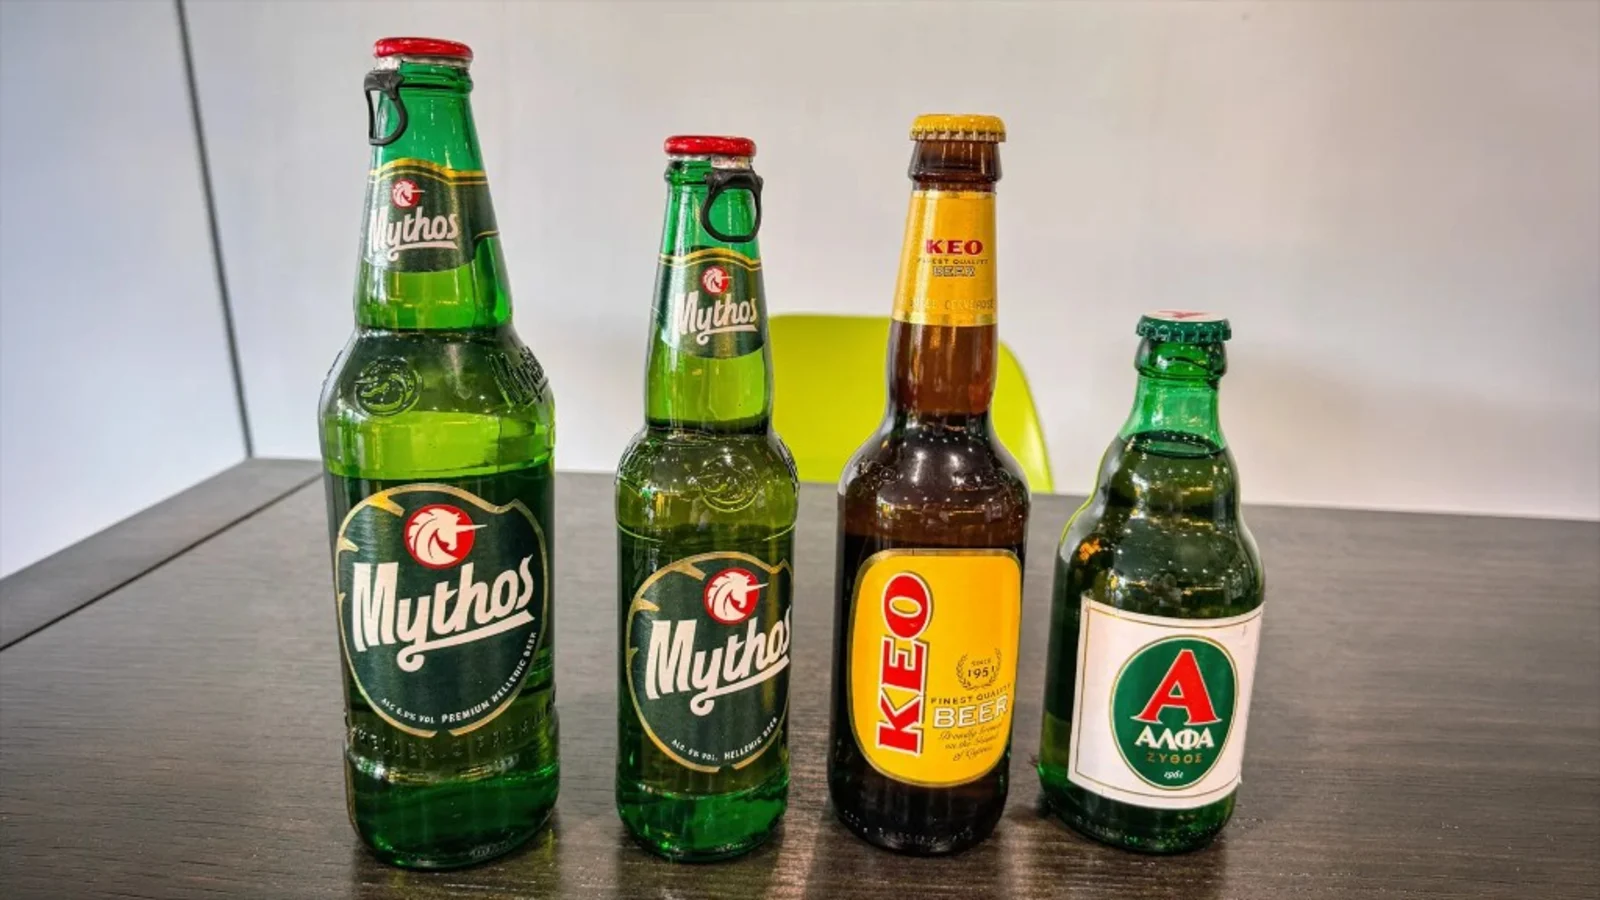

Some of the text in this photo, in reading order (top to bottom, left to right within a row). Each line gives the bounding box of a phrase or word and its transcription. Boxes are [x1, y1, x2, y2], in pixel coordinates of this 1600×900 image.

[369, 205, 458, 261] Mythos
[926, 240, 983, 255] KEO
[933, 265, 975, 277] BEER
[675, 290, 758, 345] Mythos
[353, 554, 535, 672] Mythos
[645, 605, 791, 716] Mythos
[876, 571, 934, 757] KEO
[968, 665, 995, 679] 1951
[971, 658, 991, 667] SINCE
[441, 632, 537, 723] PREMIUM HELLENIC BEER
[930, 683, 1011, 705] FINEST QUALITY
[419, 715, 436, 724] VOL
[933, 694, 1008, 729] BEER
[724, 717, 778, 760] HELLENIC BEER
[1134, 725, 1215, 751] ΑΛΦΑ
[1146, 752, 1202, 764] ΖΥΘΟΣ
[1163, 769, 1184, 779] 1961
